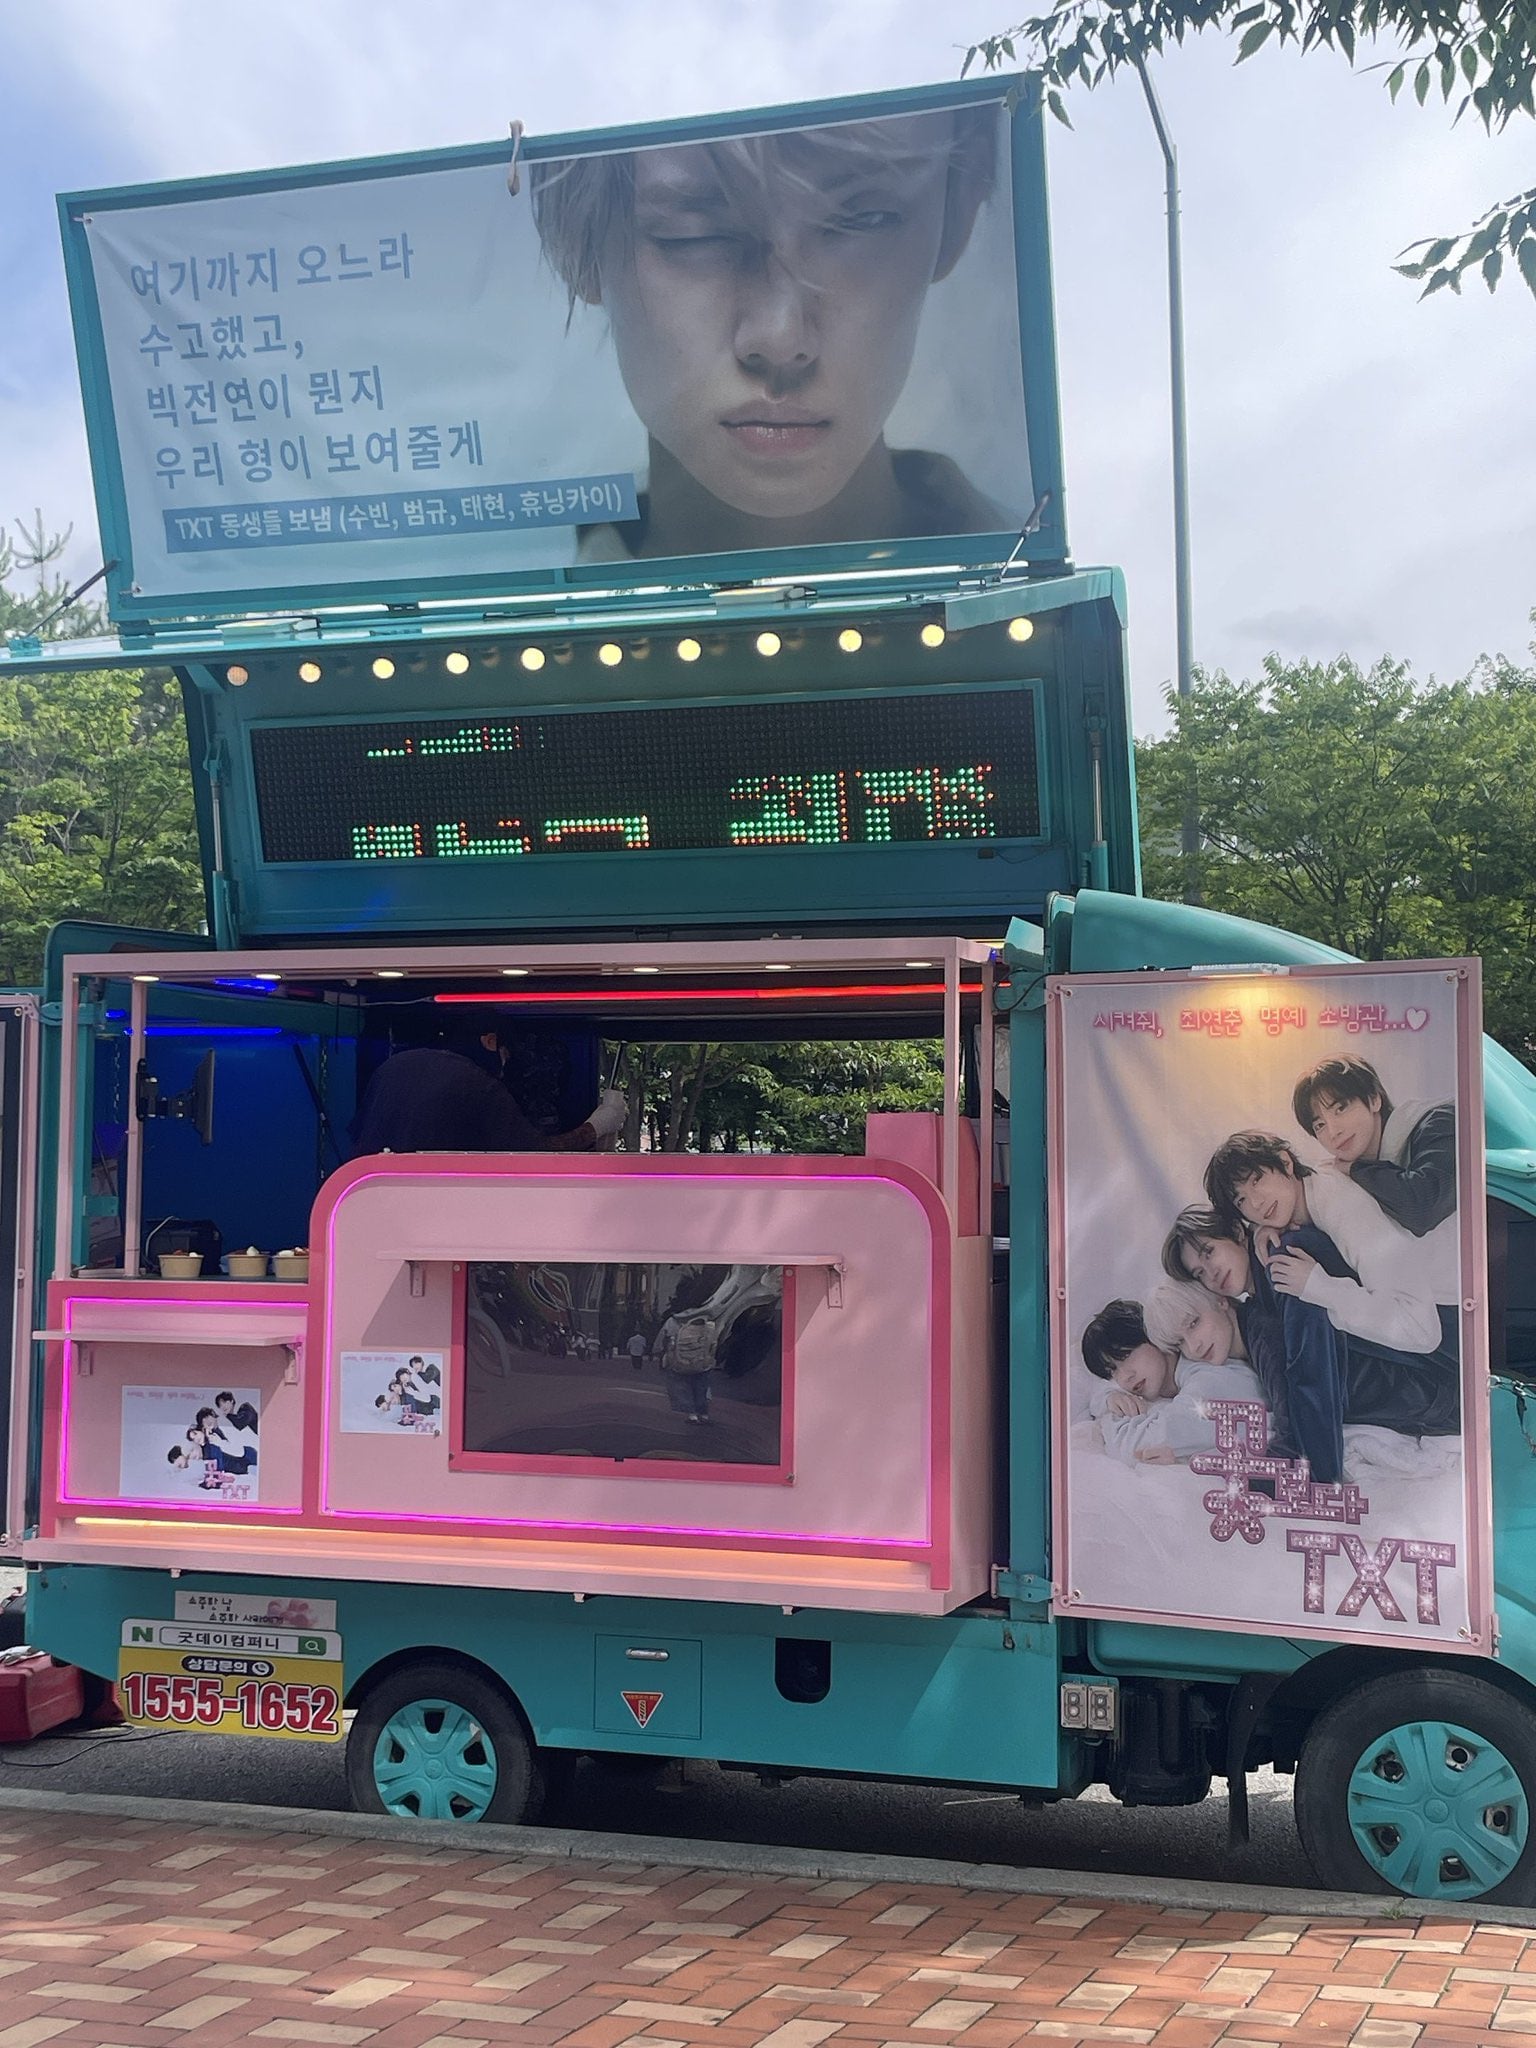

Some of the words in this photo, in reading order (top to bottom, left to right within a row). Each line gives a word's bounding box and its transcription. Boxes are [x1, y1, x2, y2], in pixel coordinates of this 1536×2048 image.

[131, 248, 278, 304] 여기까지
[297, 232, 414, 285] 오느라
[139, 315, 304, 367] 수고했고,
[147, 374, 291, 427] 빅전연이
[309, 365, 384, 415] 뭔지
[156, 442, 224, 489] 우리
[238, 435, 311, 483] 형이
[326, 420, 483, 473] 보여줄게
[175, 516, 214, 540] TXT
[220, 510, 282, 539] 동생들
[289, 505, 332, 533] 보냄
[340, 501, 398, 534] (수빈,
[403, 498, 457, 527] 범규,
[461, 492, 515, 522] 태현,
[520, 483, 622, 517] 휴닝카이)
[1094, 1010, 1163, 1038] 시켜줘,
[1181, 1008, 1243, 1037] 최연준
[1260, 1006, 1305, 1036] 명예
[1286, 1529, 1456, 1626] TXT
[178, 1631, 279, 1650] 굿데이컴퍼니
[187, 1658, 247, 1674] 상담문의
[124, 1673, 338, 1734] 1555-1652
